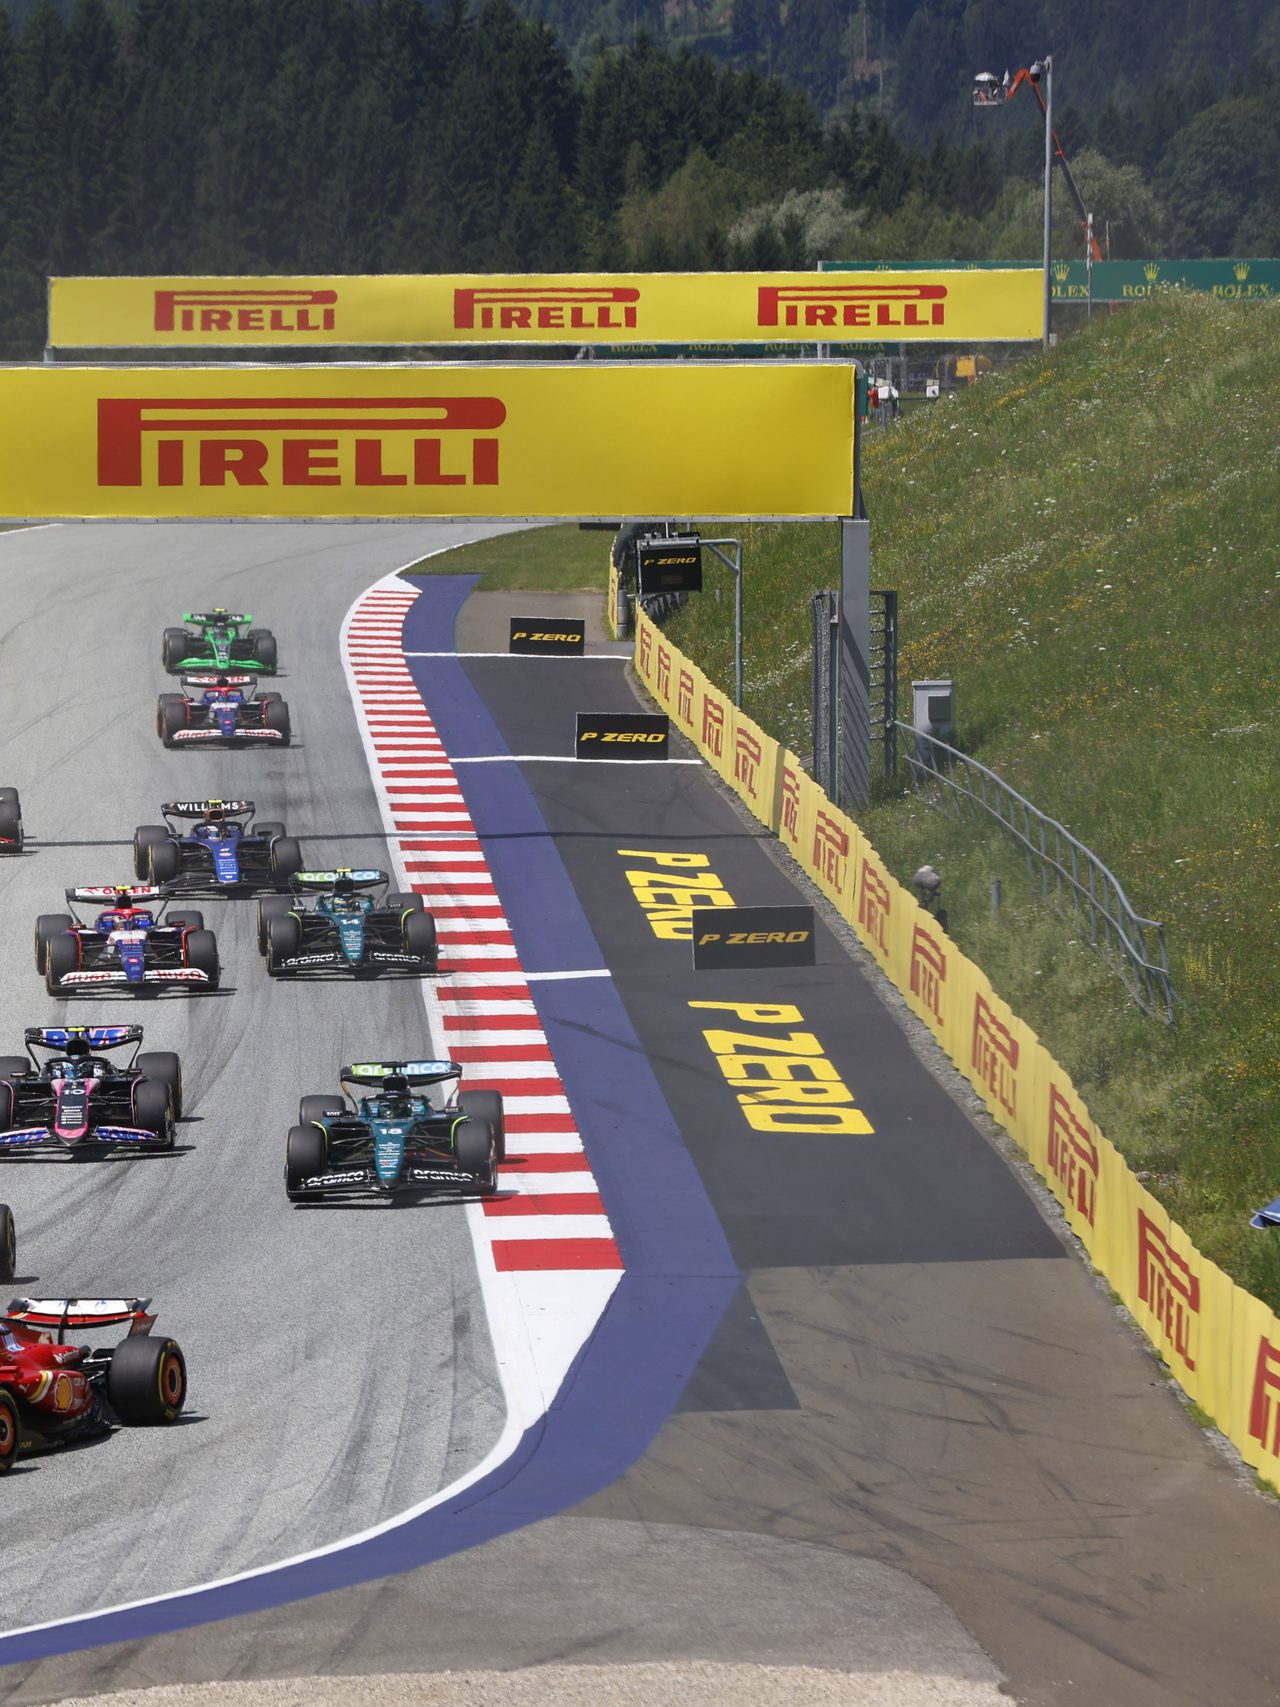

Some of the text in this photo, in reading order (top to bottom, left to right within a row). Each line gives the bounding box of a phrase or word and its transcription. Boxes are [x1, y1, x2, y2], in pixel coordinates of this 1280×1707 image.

[156, 291, 336, 331] PIRELLI
[455, 289, 639, 329] PIRELLI
[759, 285, 947, 326] PIRELLI
[99, 398, 505, 486] PIRELLI
[513, 632, 582, 643] P ZERO
[581, 731, 666, 744] P ZERO
[177, 802, 239, 812] WILLMS
[699, 931, 809, 945] P ZERO
[688, 1001, 875, 1135] P ZERO
[307, 1170, 364, 1186] aramco
[413, 1169, 472, 1182] aramco
